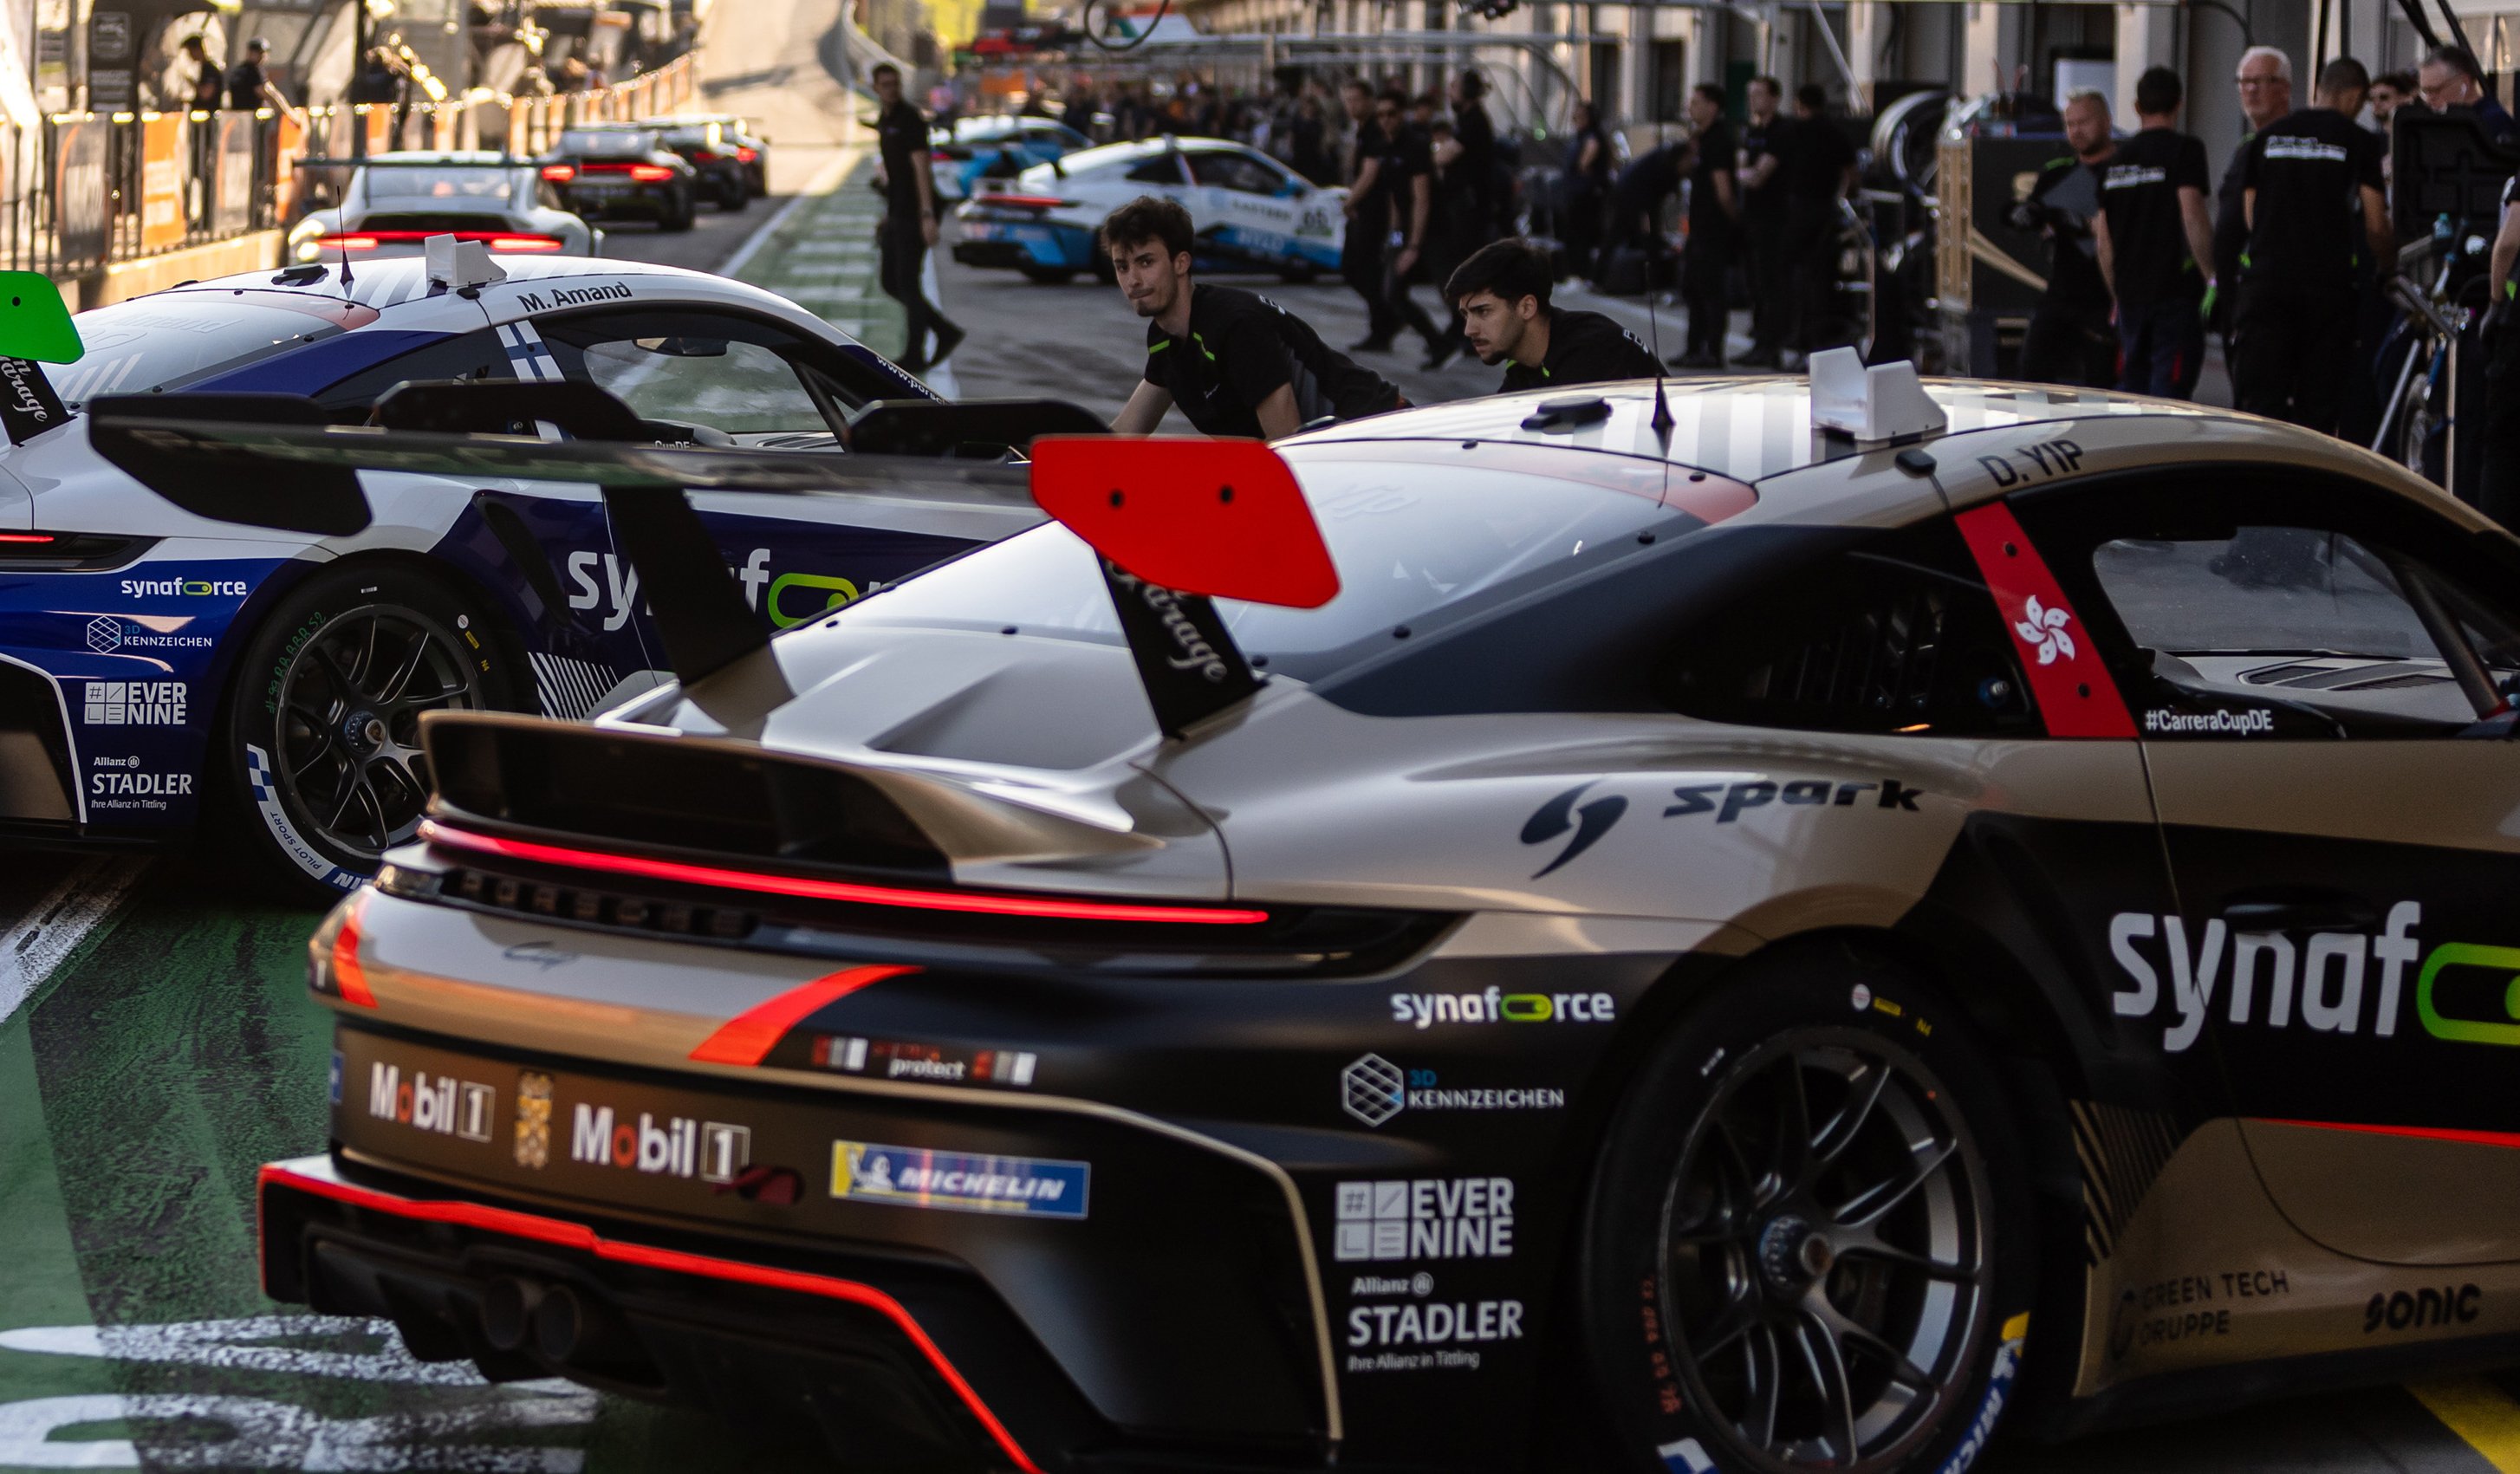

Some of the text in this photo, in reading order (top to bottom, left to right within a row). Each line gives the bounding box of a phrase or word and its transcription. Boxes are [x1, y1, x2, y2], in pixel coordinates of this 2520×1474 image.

[516, 281, 633, 312] M. Amand
[0, 355, 48, 422] arage
[120, 577, 247, 599] synaforce
[124, 624, 141, 635] 3D
[124, 635, 213, 647] KENNZEICHEN
[128, 682, 187, 704] EVER
[127, 704, 186, 725] NINE
[2145, 709, 2275, 736] #CarreraCupDE
[94, 756, 127, 767] Allianz
[92, 773, 192, 795] STADLER
[91, 799, 167, 811] Ihre Allianz in Tittling
[1663, 778, 1926, 825] spark
[270, 811, 323, 870] PILOT SPORT
[1390, 985, 1616, 1029] synaforce
[887, 1058, 966, 1081] protect
[370, 1061, 458, 1134] Mobil
[1408, 1088, 1565, 1108] KENNZEICHEN
[571, 1102, 696, 1179] Mobil
[898, 1166, 1066, 1201] MICHELIN
[1412, 1178, 1515, 1219] EVER
[1410, 1216, 1514, 1259] NINE
[1351, 1276, 1410, 1295] Allianz
[2220, 1269, 2289, 1298] TECH
[1348, 1301, 1524, 1347] STADLER
[1348, 1354, 1375, 1372] Ihre
[1376, 1353, 1419, 1370] Allianz
